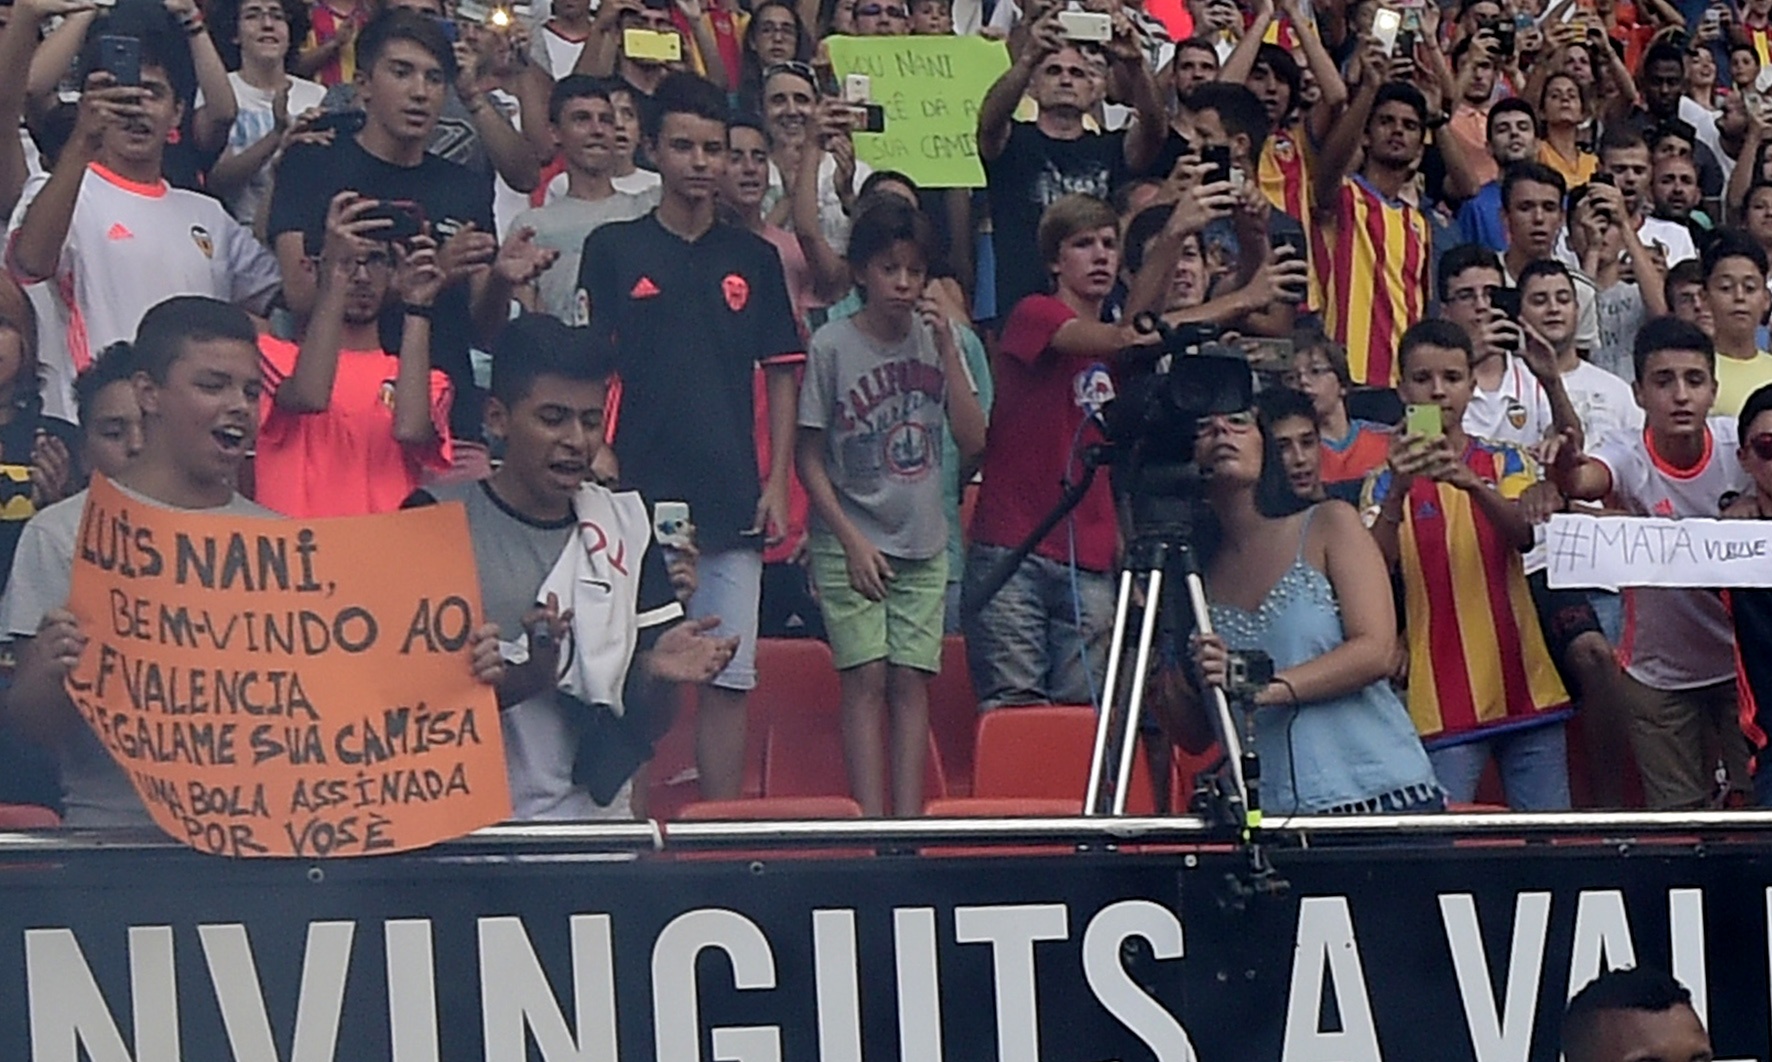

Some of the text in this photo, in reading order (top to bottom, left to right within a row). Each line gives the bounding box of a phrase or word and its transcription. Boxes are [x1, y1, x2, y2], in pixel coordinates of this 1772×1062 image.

[920, 132, 978, 159] CAMI
[1554, 520, 1698, 573] #MATA
[110, 588, 472, 656] BEM-VINDO AO
[250, 724, 327, 766] SUA
[187, 781, 271, 818] BOLA
[183, 815, 268, 857] POR
